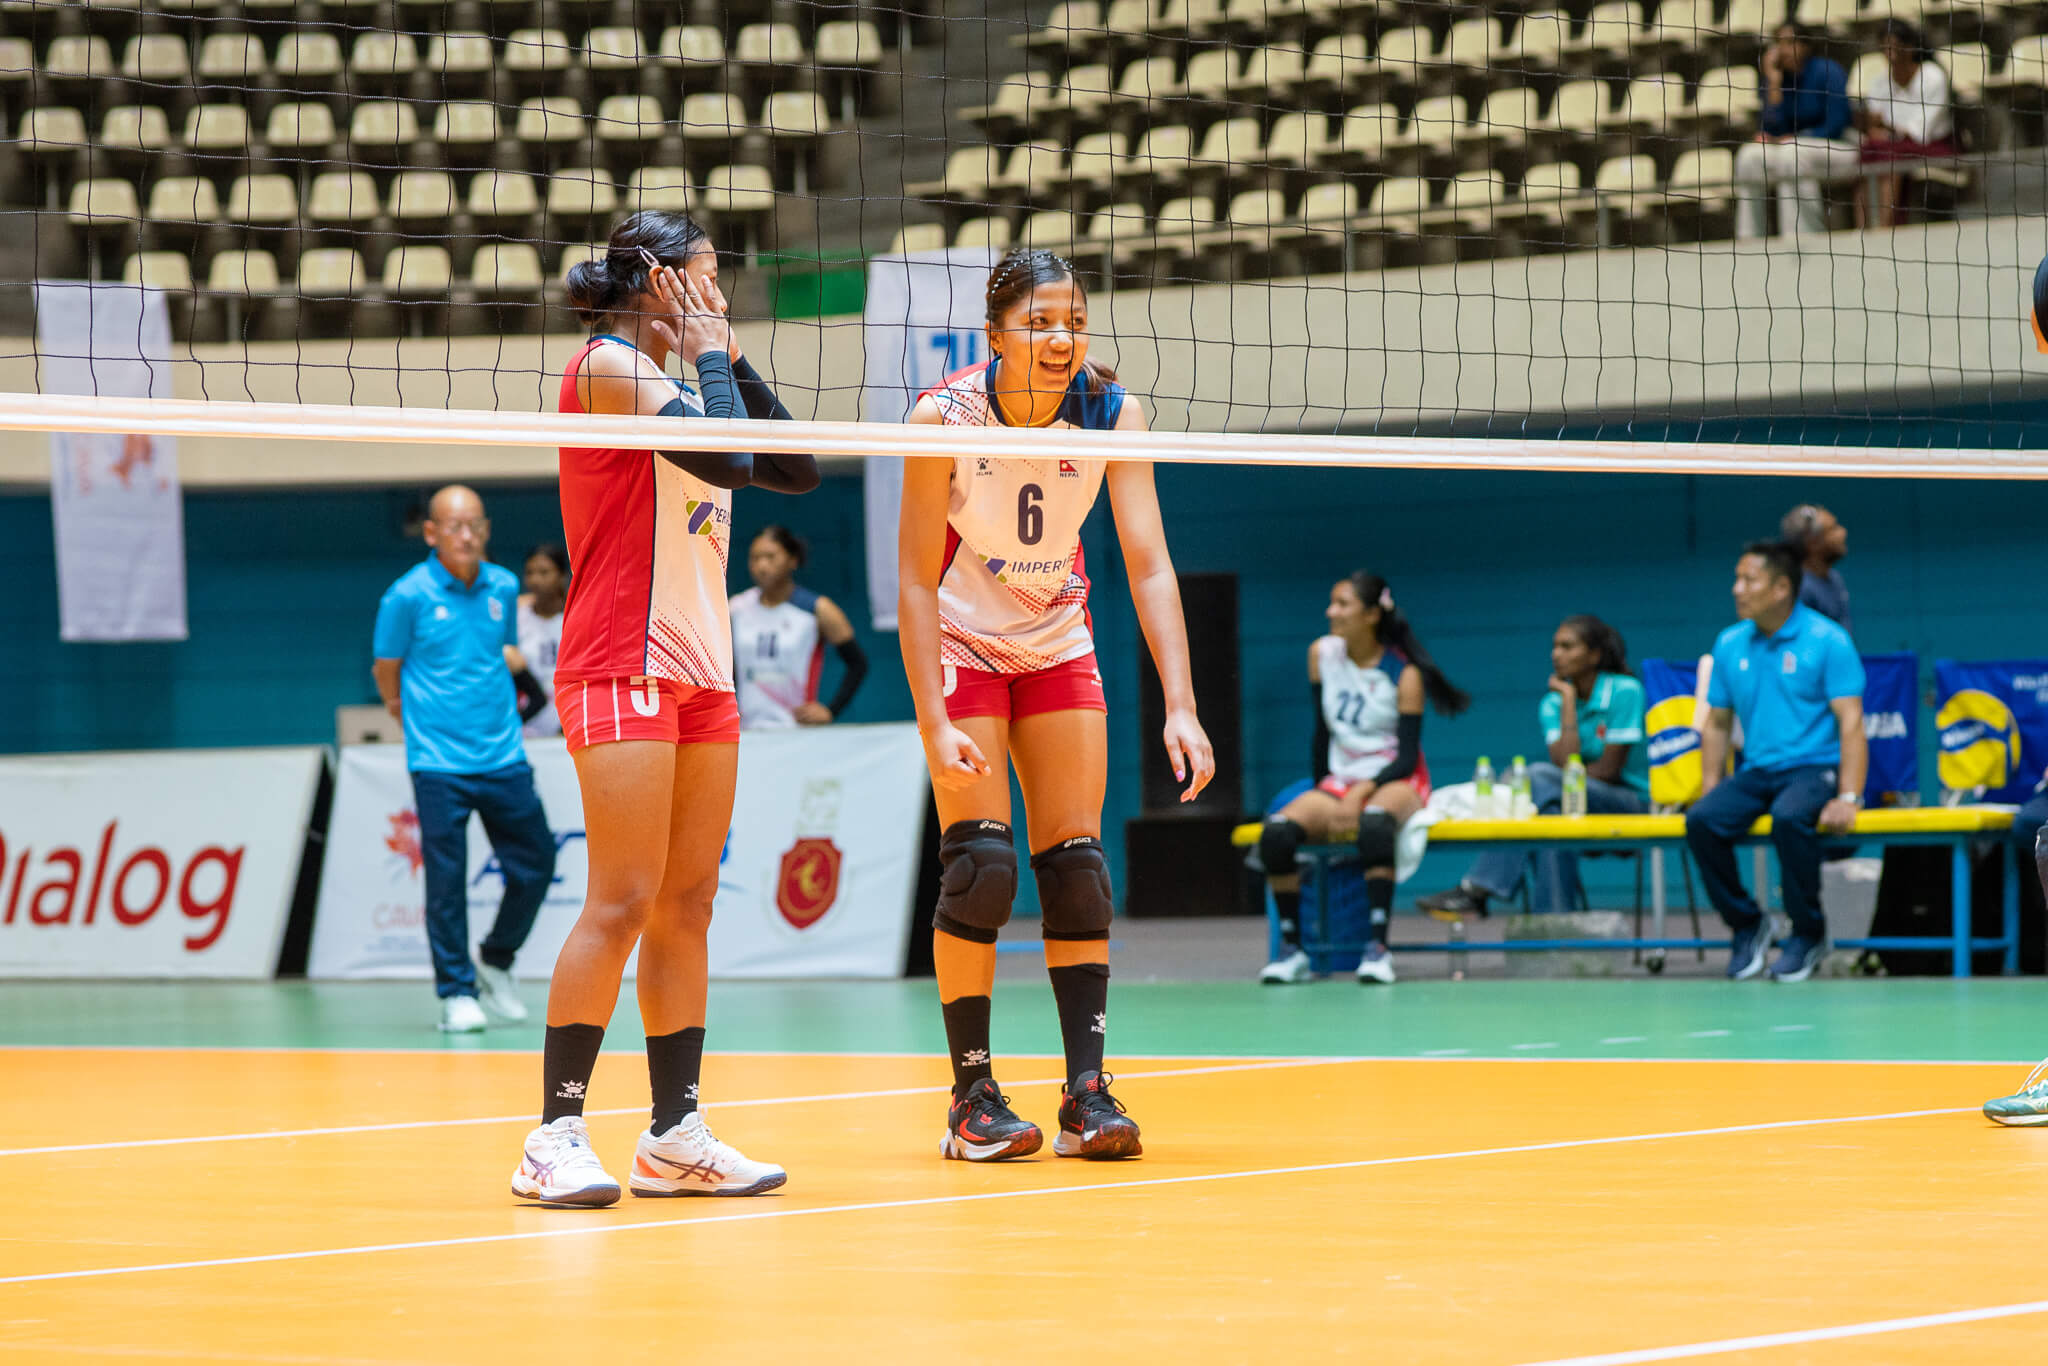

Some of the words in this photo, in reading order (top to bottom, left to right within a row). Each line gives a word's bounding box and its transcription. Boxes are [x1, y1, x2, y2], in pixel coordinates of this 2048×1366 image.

[1017, 483, 1044, 546] 6
[1336, 690, 1366, 727] 22
[0, 817, 247, 953] ialog
